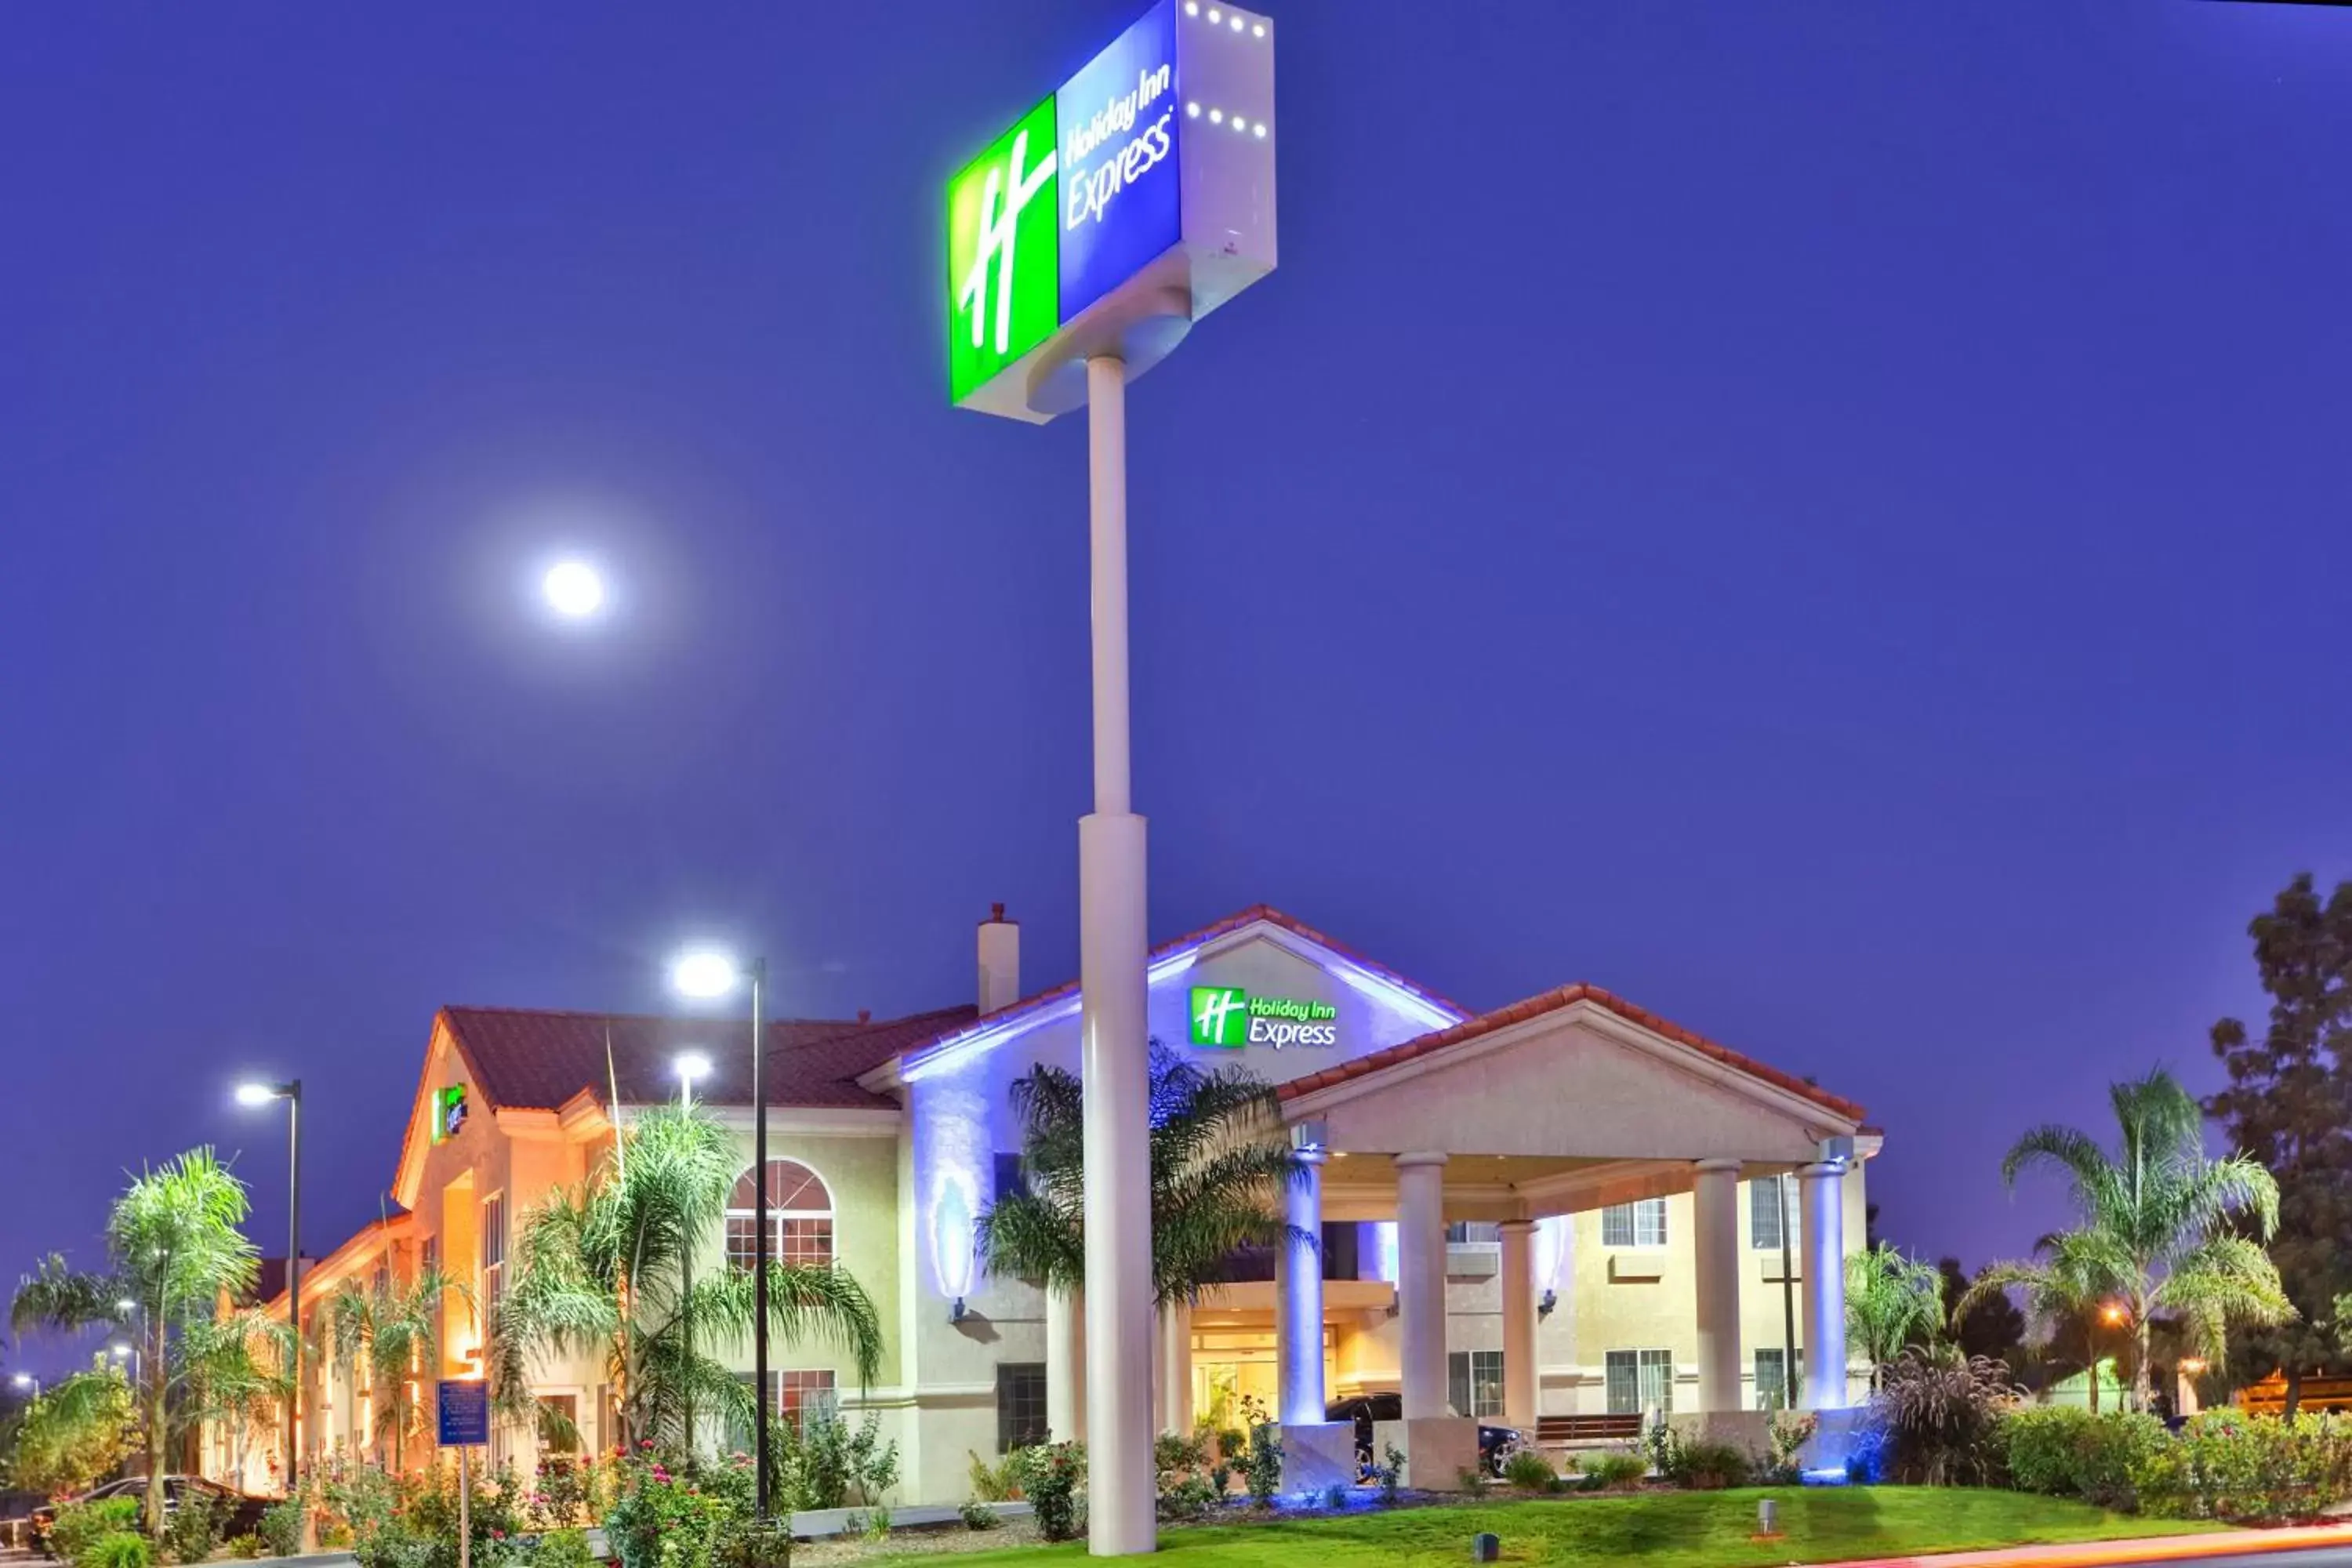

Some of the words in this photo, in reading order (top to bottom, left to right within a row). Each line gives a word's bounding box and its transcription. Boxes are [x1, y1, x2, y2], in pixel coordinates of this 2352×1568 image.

[1065, 89, 1138, 169] Holiday
[1139, 64, 1170, 109] Inn
[1066, 113, 1171, 231] Express
[1249, 1017, 1337, 1050] Express
[1250, 997, 1309, 1022] Holiday
[1312, 1000, 1336, 1018] Inn
